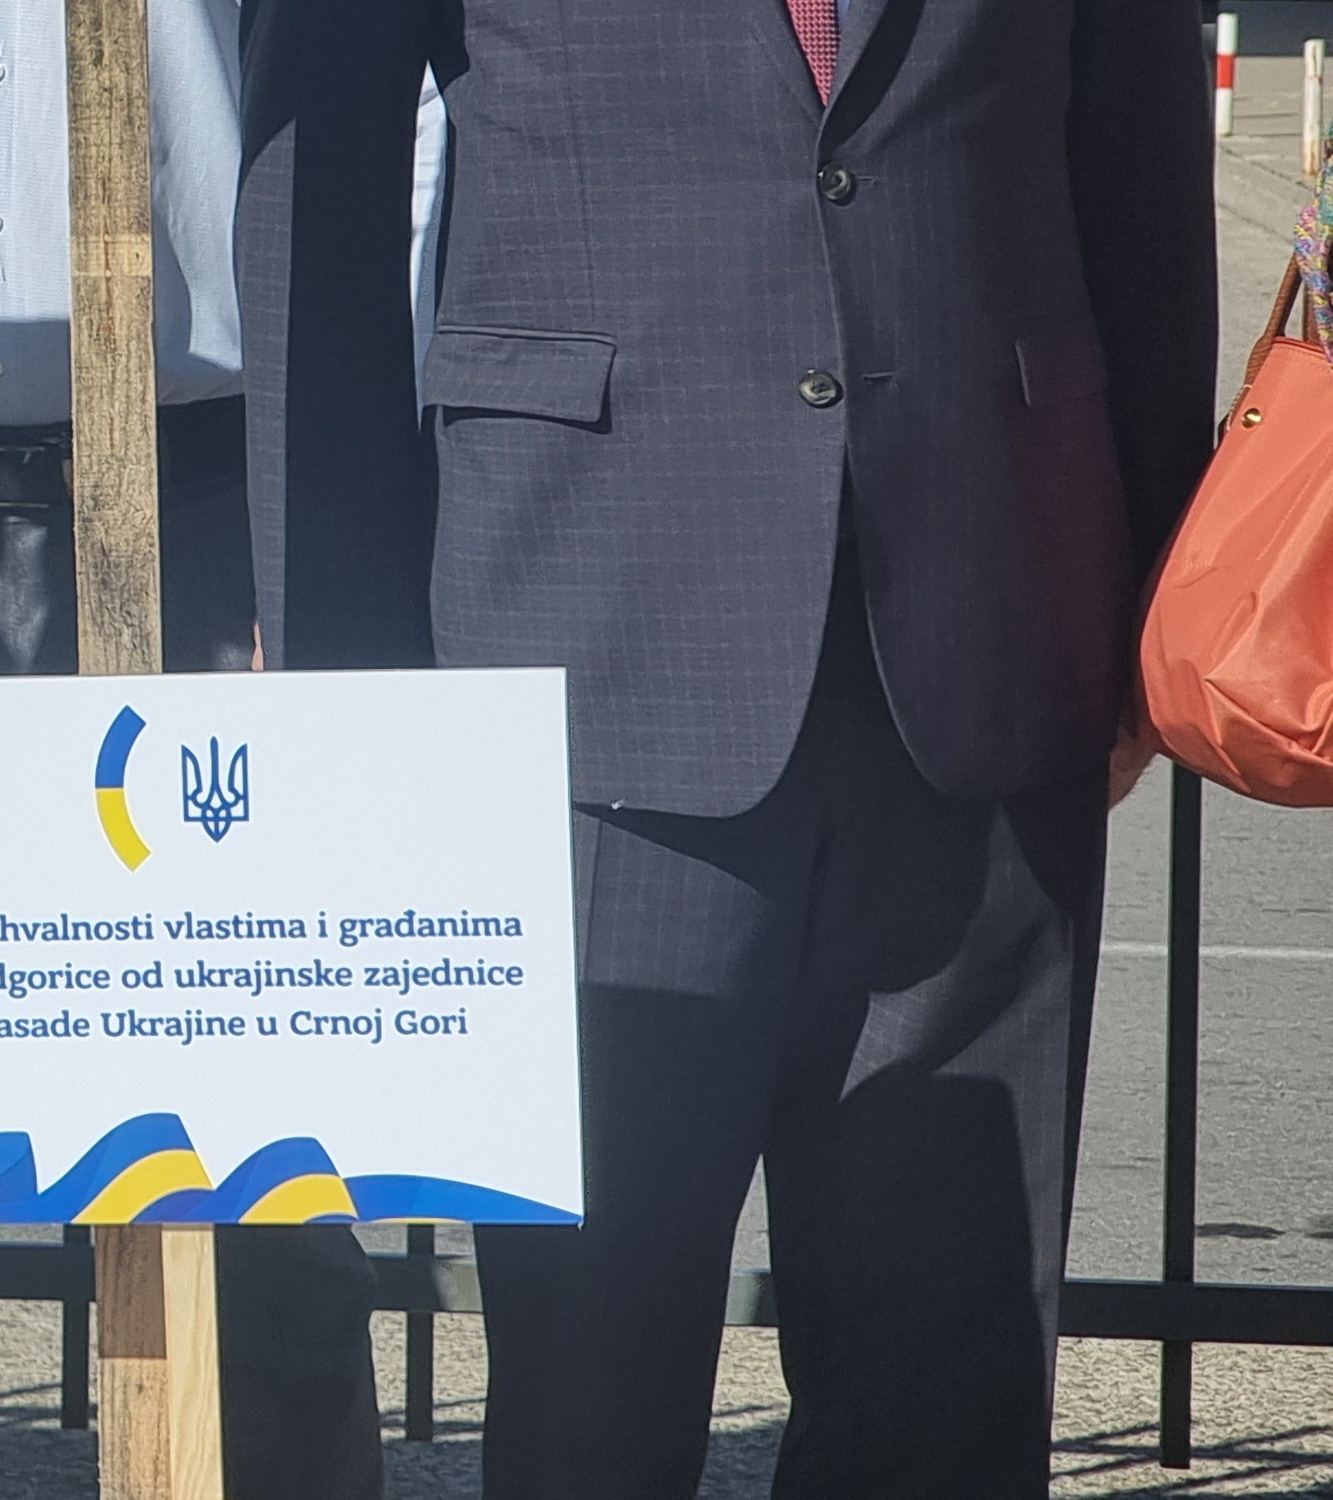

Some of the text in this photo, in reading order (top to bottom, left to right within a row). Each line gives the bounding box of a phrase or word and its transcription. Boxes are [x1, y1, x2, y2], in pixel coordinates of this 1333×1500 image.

[163, 911, 308, 940] vlastima
[317, 910, 329, 938] i
[338, 909, 524, 948] građanima
[121, 960, 164, 989] od
[173, 958, 353, 997] ukrajinske
[363, 957, 524, 996] zajednice
[100, 1008, 246, 1046] Ukrajine
[255, 1016, 279, 1037] u
[289, 1007, 382, 1045] Crnoj
[394, 1007, 468, 1036] Gori
